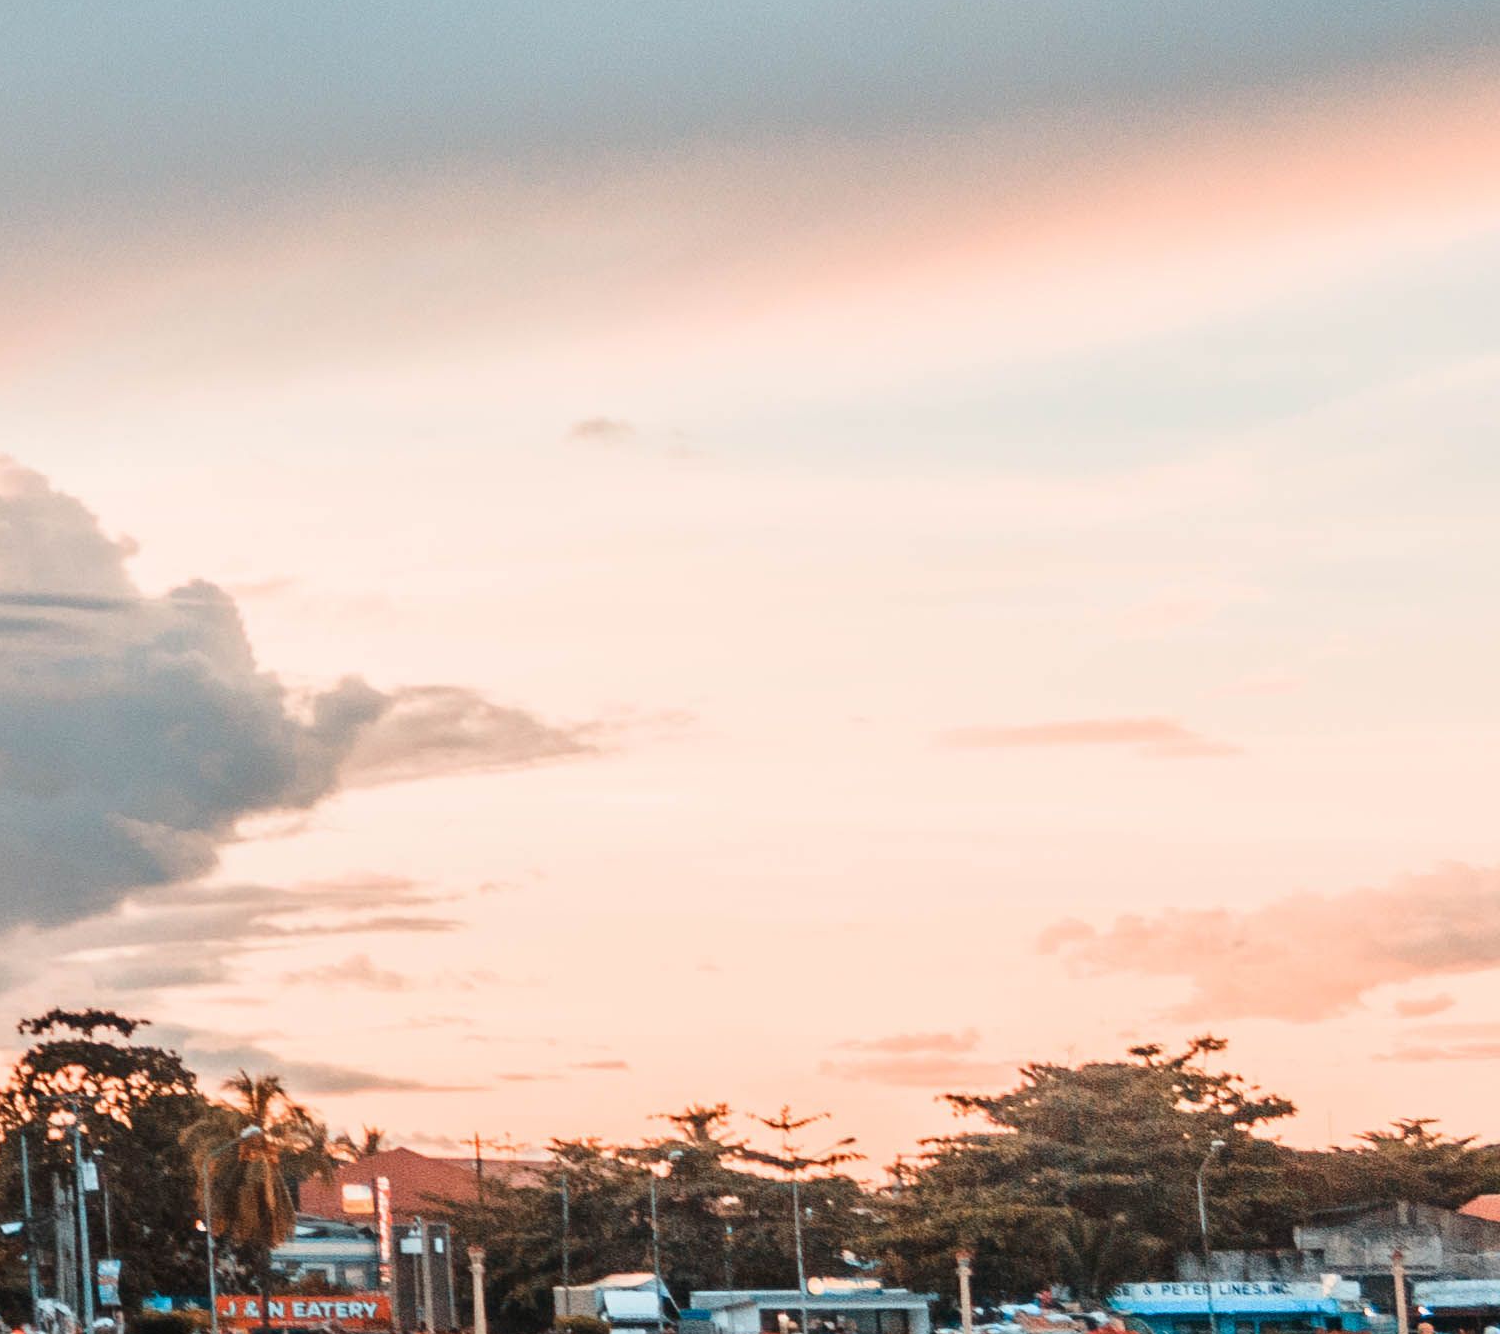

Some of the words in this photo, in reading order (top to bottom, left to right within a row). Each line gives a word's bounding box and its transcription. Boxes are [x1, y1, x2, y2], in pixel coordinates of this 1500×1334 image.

[222, 1300, 237, 1317] J
[244, 1300, 260, 1318] &
[267, 1300, 285, 1318] N
[291, 1300, 378, 1319] EATERY
